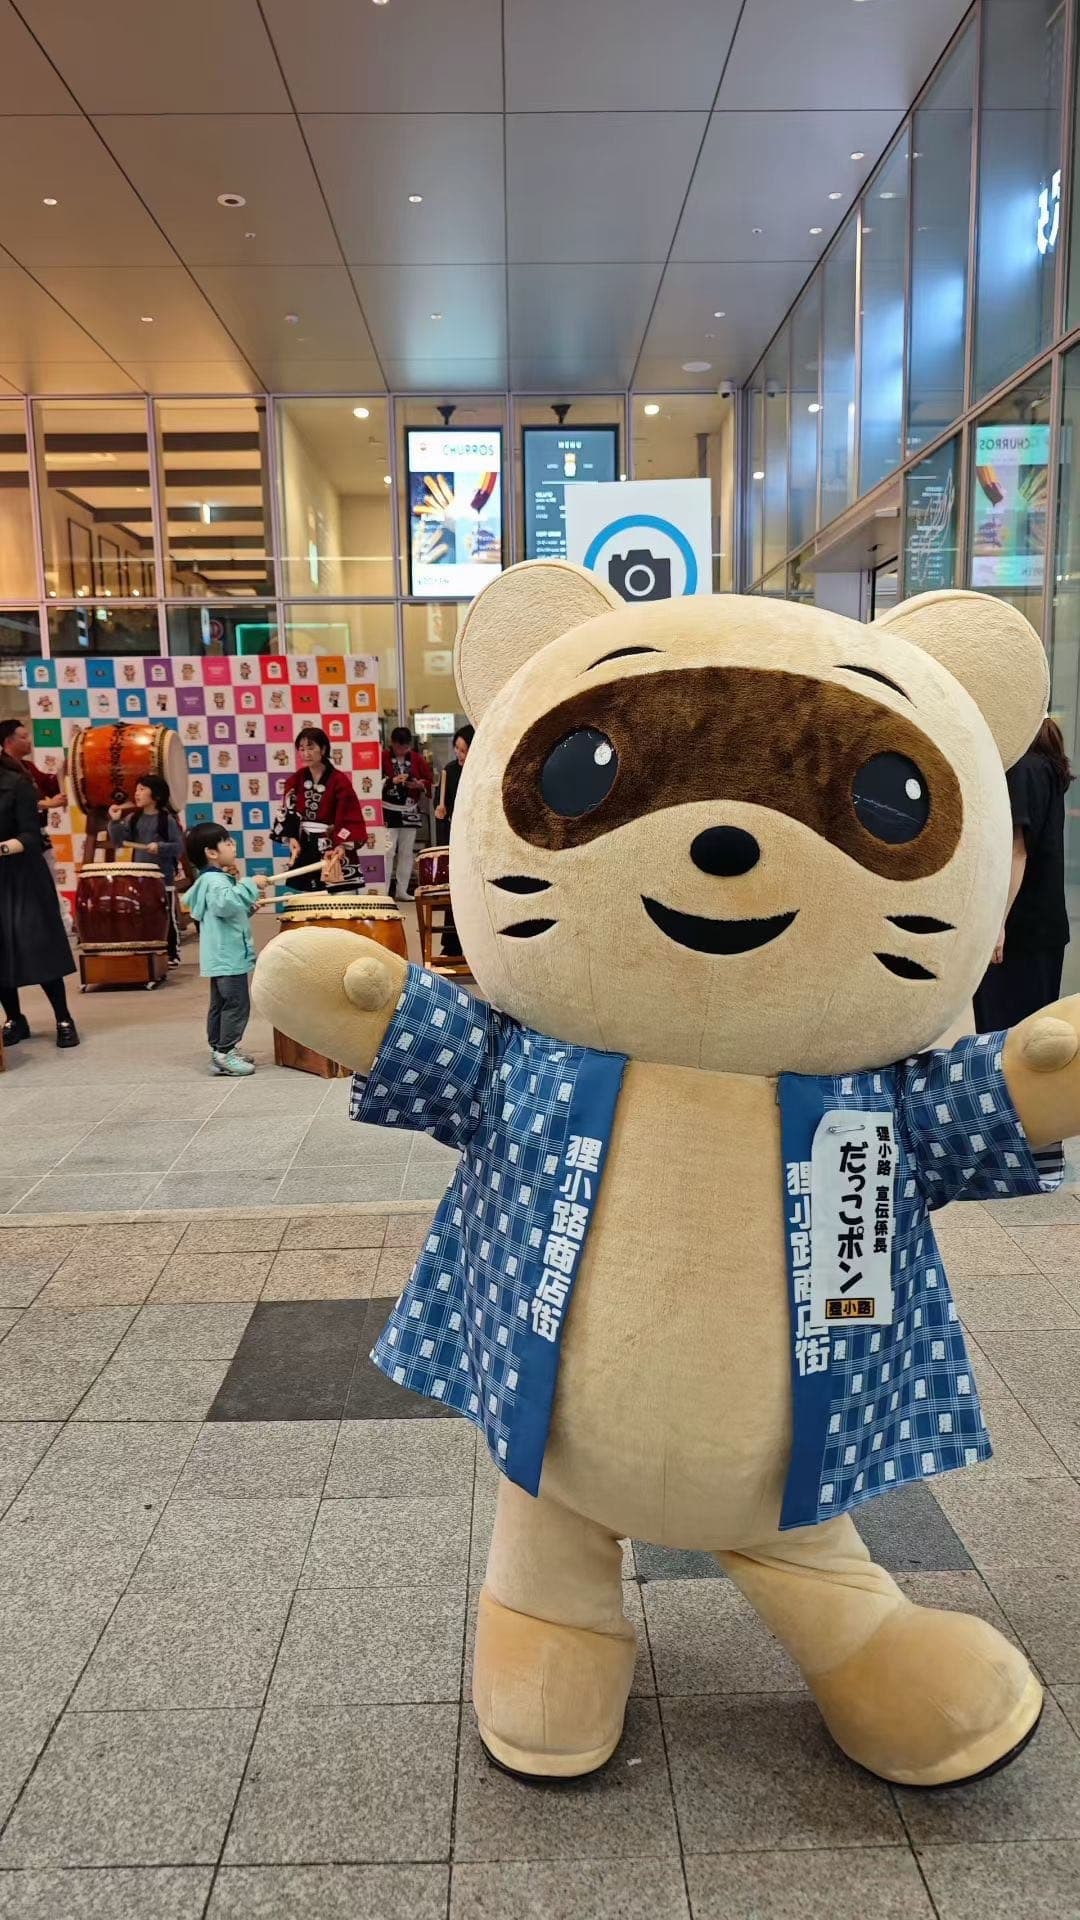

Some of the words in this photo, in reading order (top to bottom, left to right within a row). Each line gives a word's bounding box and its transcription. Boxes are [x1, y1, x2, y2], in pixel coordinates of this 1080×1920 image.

[442, 444, 495, 456] CHURROS
[875, 1126, 893, 1176] 狸小路
[530, 1134, 603, 1342] 狸小路商店街
[837, 1141, 869, 1294] だっこポン
[873, 1186, 891, 1253] 宣伝係長
